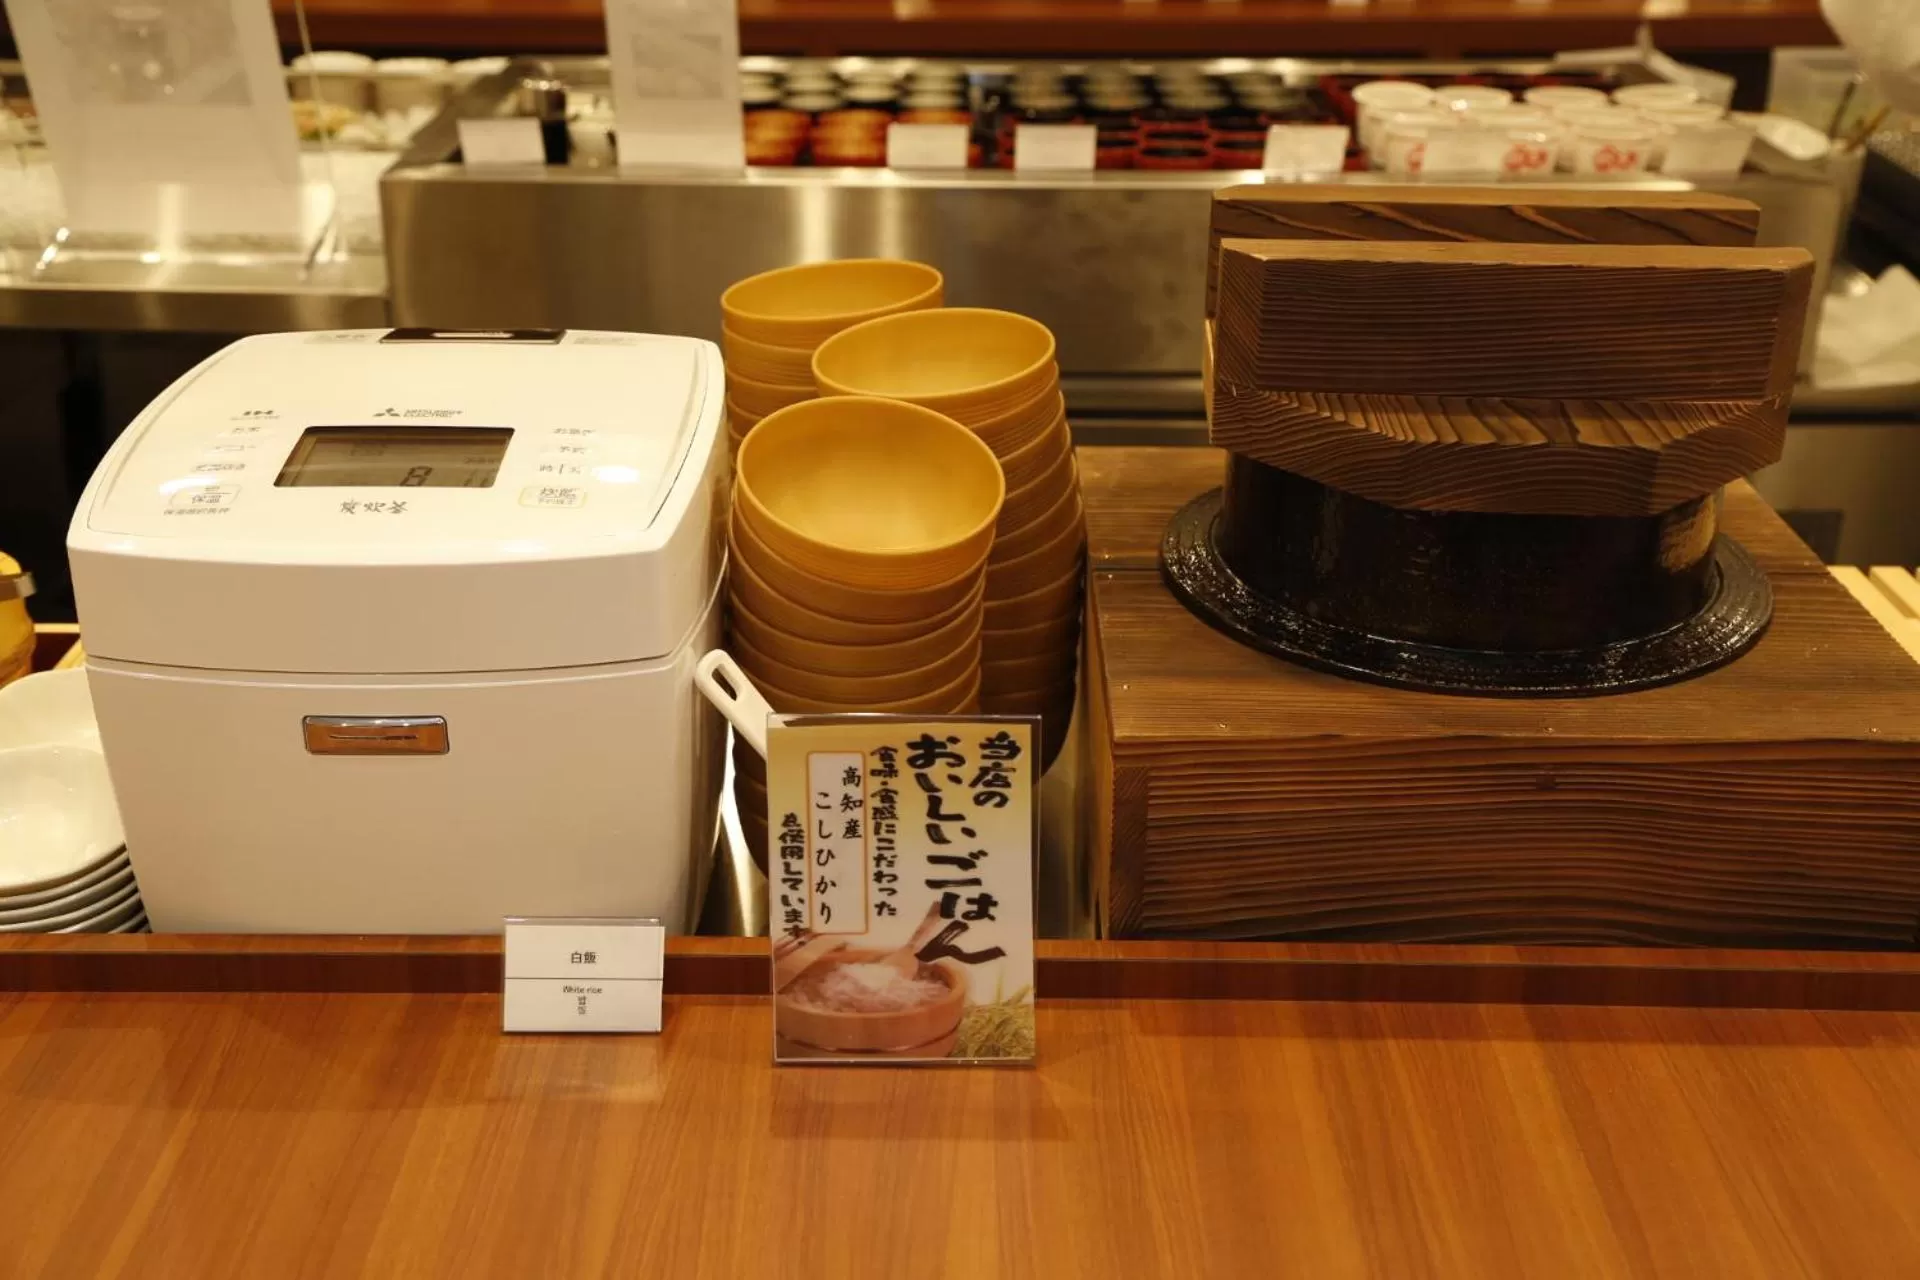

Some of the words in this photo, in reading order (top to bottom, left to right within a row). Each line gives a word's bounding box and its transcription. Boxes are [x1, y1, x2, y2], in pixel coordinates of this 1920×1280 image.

[840, 766, 864, 839] 高知産
[968, 731, 1022, 808] 当店の
[815, 791, 837, 925] こしひかり
[906, 733, 1006, 964] おいしいごはん
[563, 985, 585, 994] White
[586, 986, 602, 994] rice
[571, 950, 597, 964] 白飯
